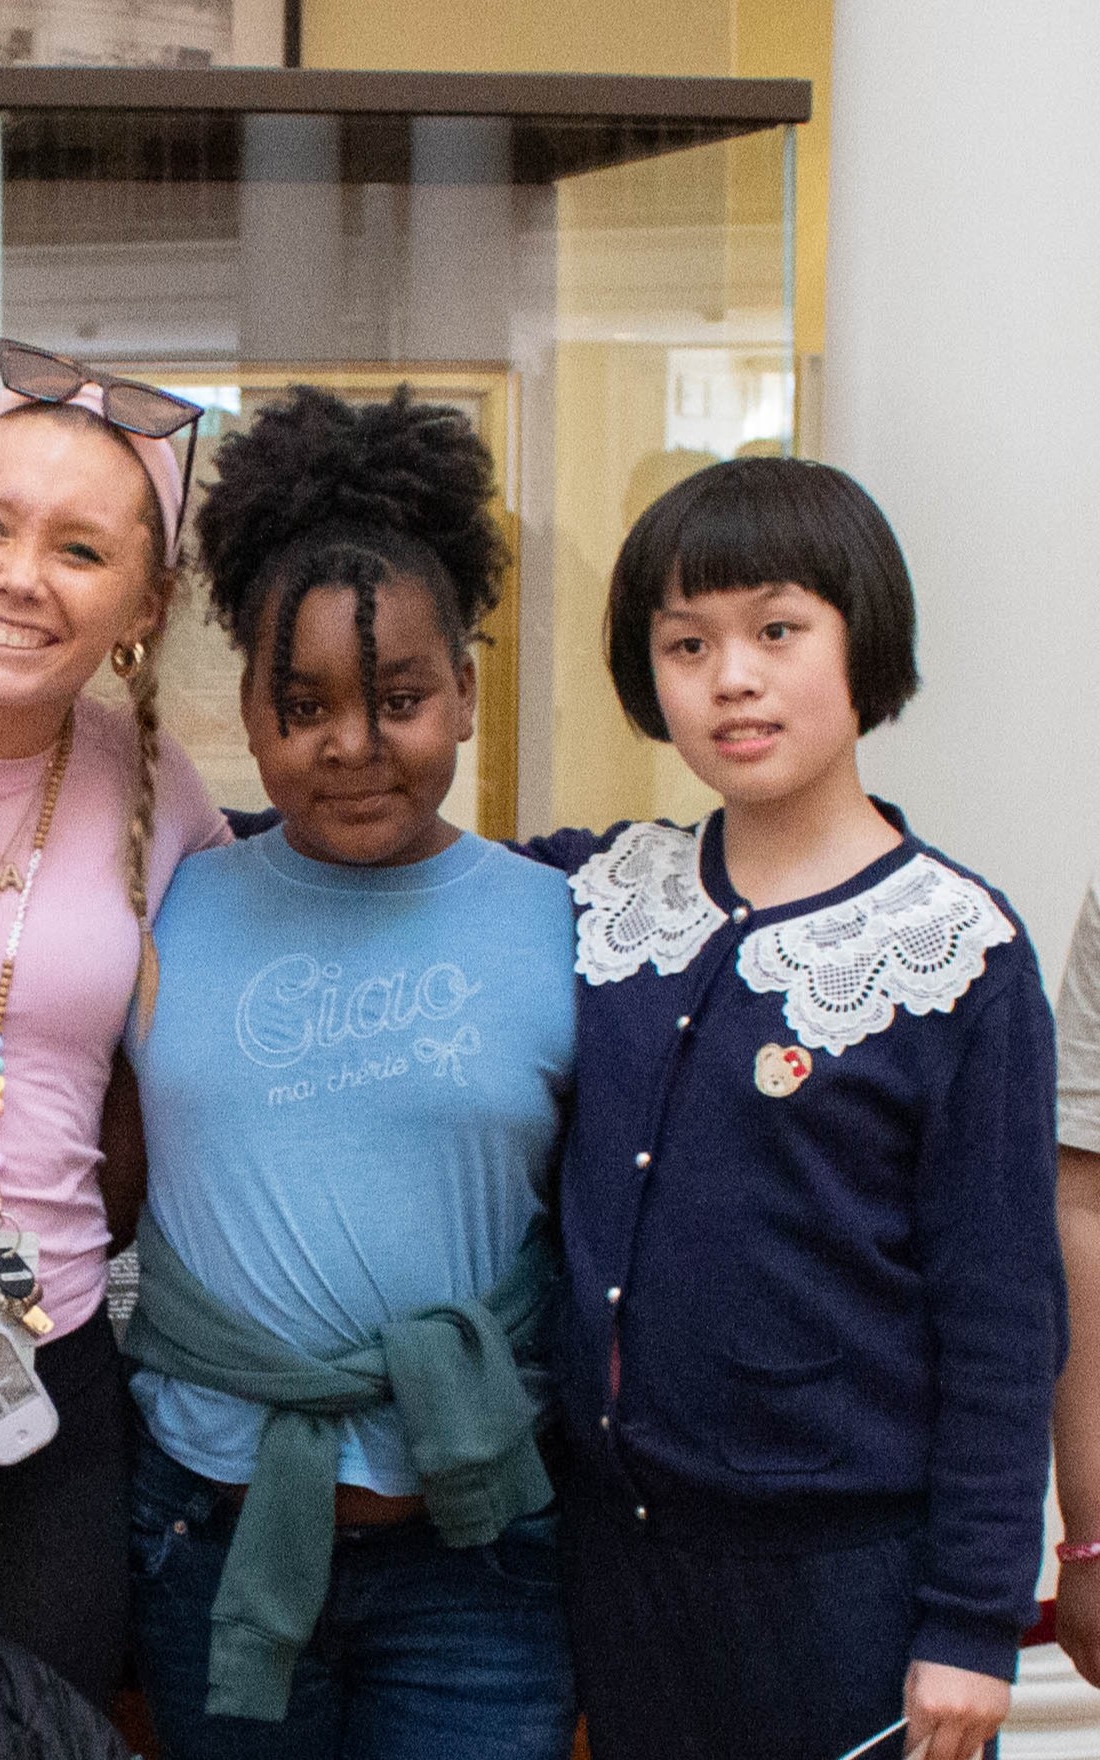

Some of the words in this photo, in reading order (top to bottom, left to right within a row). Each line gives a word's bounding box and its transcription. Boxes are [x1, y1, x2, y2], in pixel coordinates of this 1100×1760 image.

[0, 862, 23, 892] A
[235, 953, 482, 1068] Ciao
[267, 1079, 314, 1105] ma
